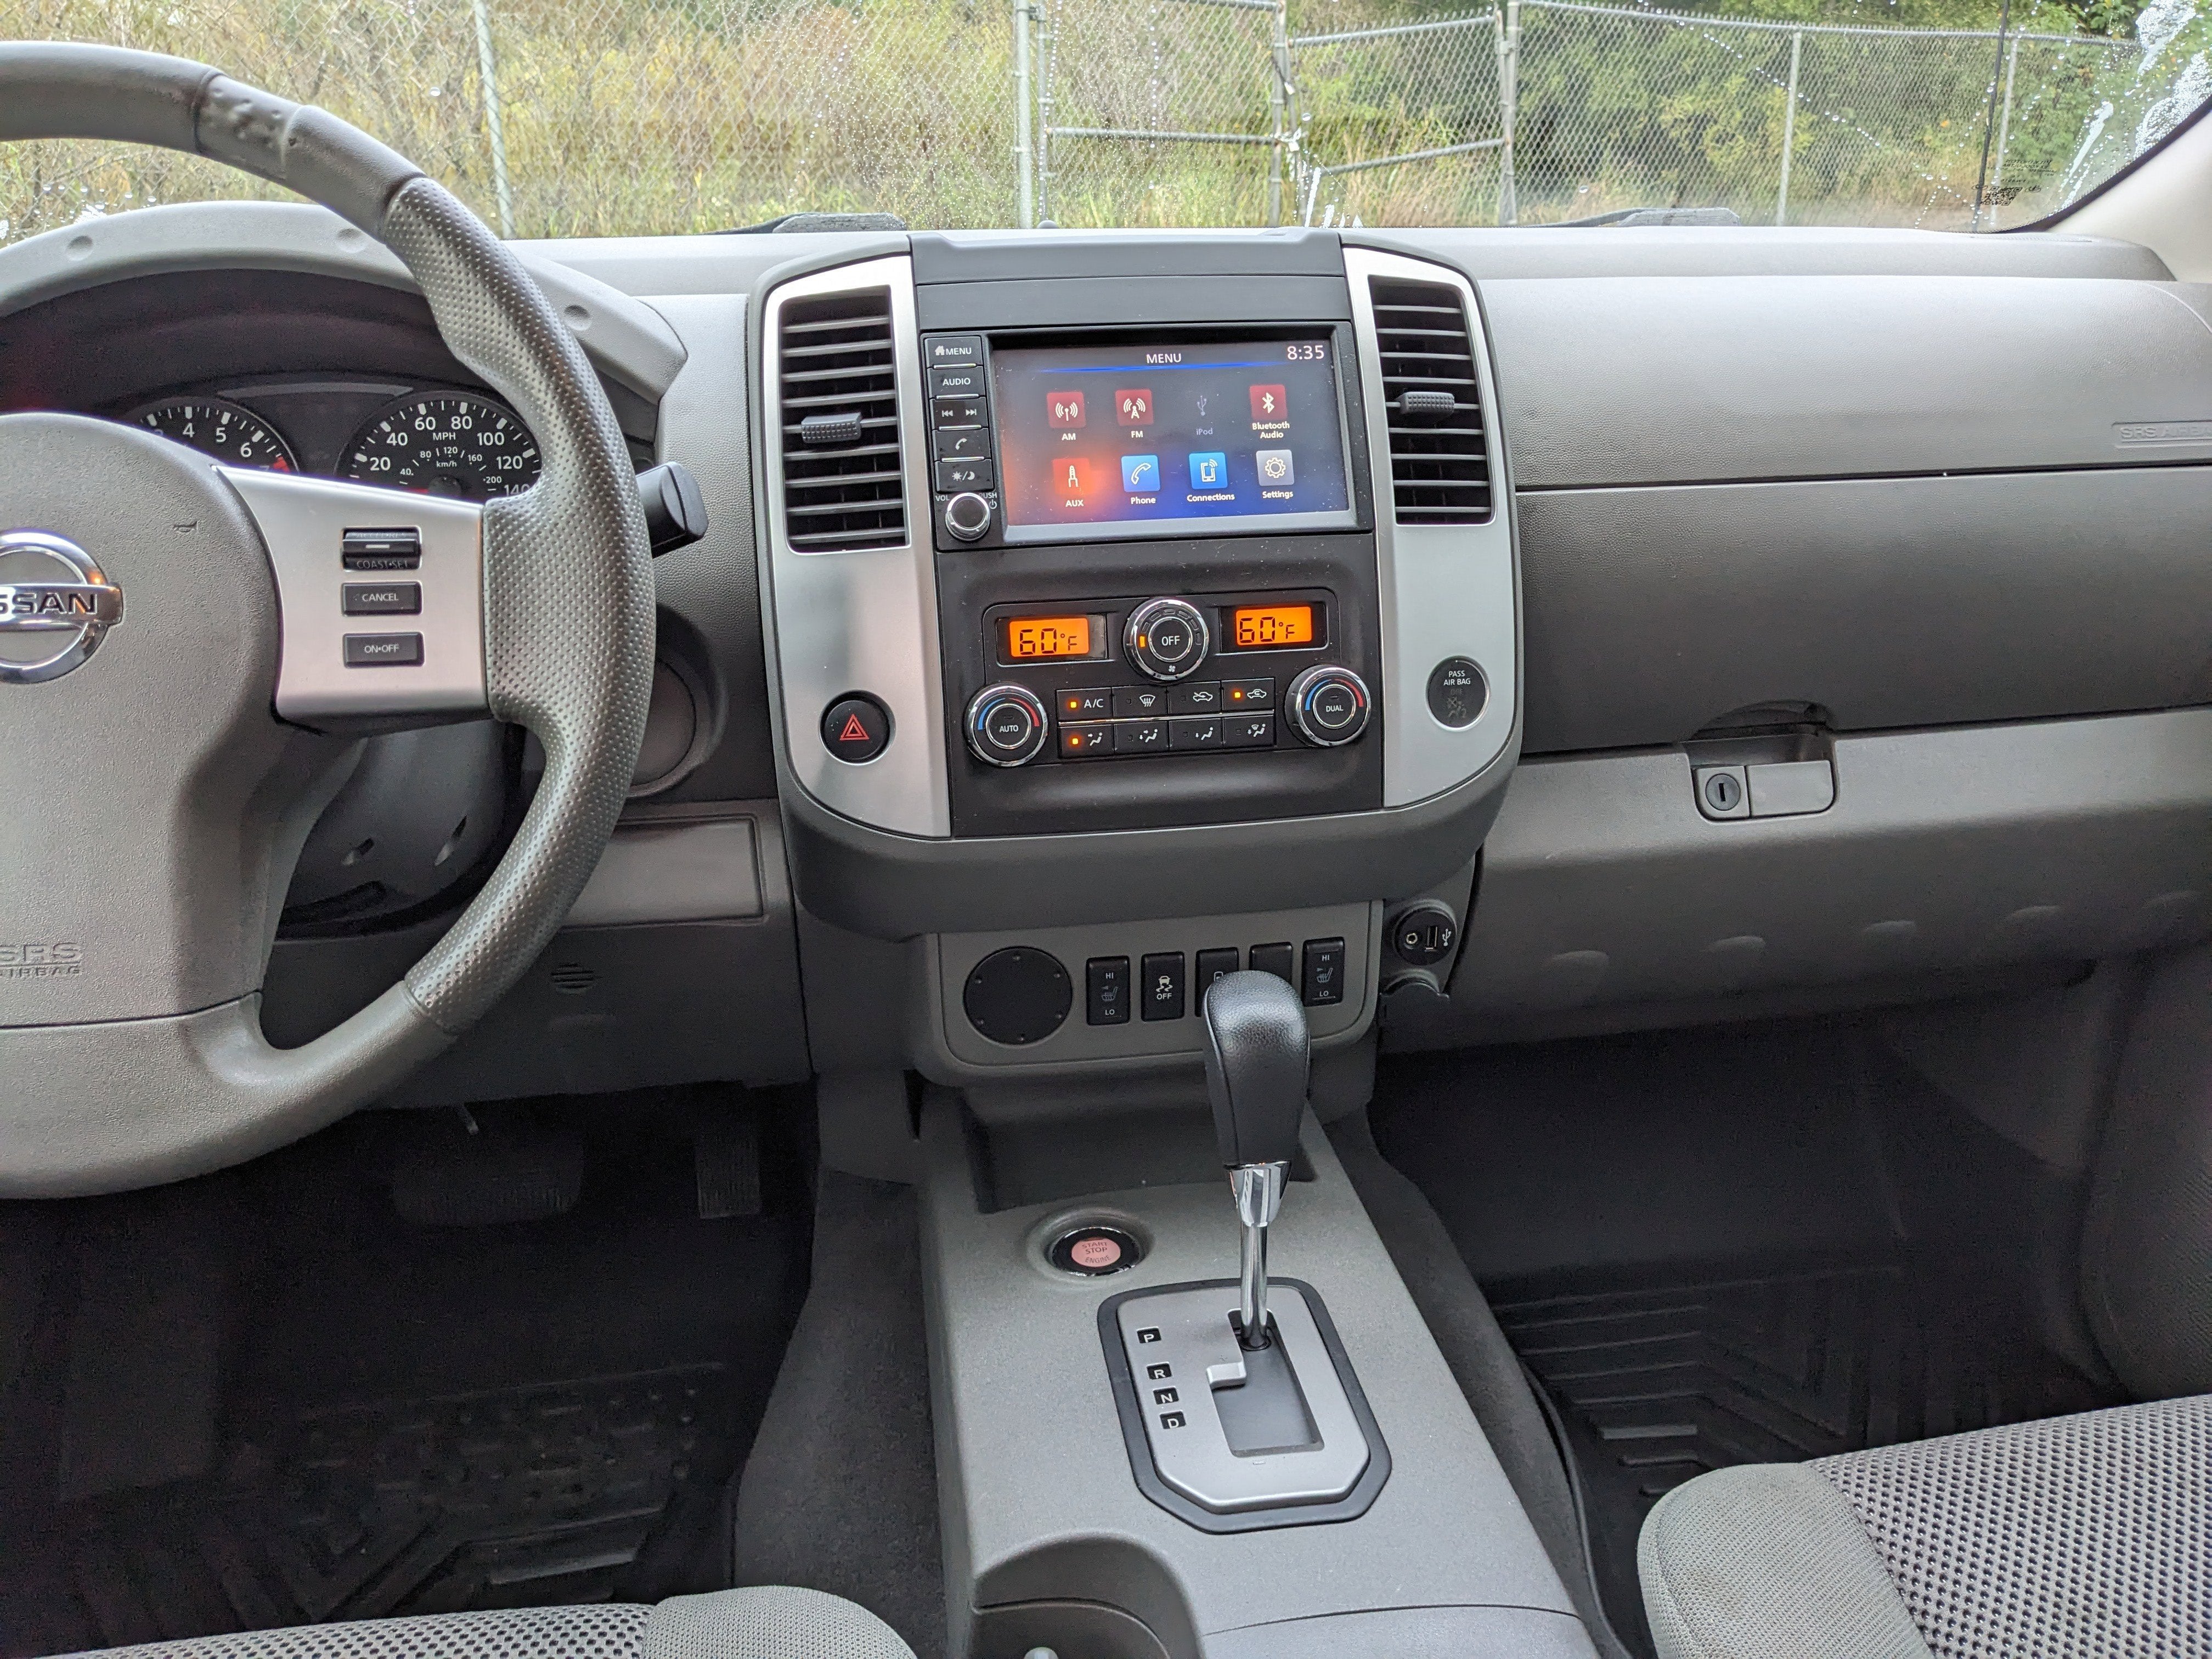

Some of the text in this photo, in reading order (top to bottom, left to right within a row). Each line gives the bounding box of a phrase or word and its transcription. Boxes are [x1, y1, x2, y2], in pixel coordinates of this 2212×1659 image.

[946, 347, 972, 356] MENU
[1287, 346, 1324, 360] 8:35
[1146, 353, 1182, 364] MENU
[415, 416, 436, 431] 60
[451, 416, 472, 430] 80
[1252, 421, 1290, 431] Bluetooth
[183, 422, 195, 437] 4
[1131, 430, 1144, 438] FM
[1196, 427, 1213, 436] iPod
[1260, 430, 1284, 439] Audio
[216, 427, 227, 443] 5
[386, 432, 408, 446] 40
[432, 432, 456, 441] MPH
[477, 432, 505, 446] 100
[1062, 432, 1076, 441] AM
[240, 442, 252, 458] 6
[370, 457, 391, 471] 20
[496, 456, 523, 470] 120
[1187, 492, 1235, 503] Connections
[1262, 489, 1294, 500] Settings
[1065, 499, 1084, 507] AUX
[1130, 496, 1156, 505] Phone
[362, 593, 399, 602] CANCEL
[1161, 635, 1180, 647] OFF
[1084, 698, 1104, 709] A/C
[1325, 704, 1344, 713] DUAL
[999, 724, 1019, 733] AUTO
[1085, 1255, 1111, 1263] ENGINE
[1144, 1333, 1154, 1343] P
[1154, 1369, 1165, 1378] R
[1161, 1393, 1172, 1403] N
[1168, 1418, 1178, 1428] D
